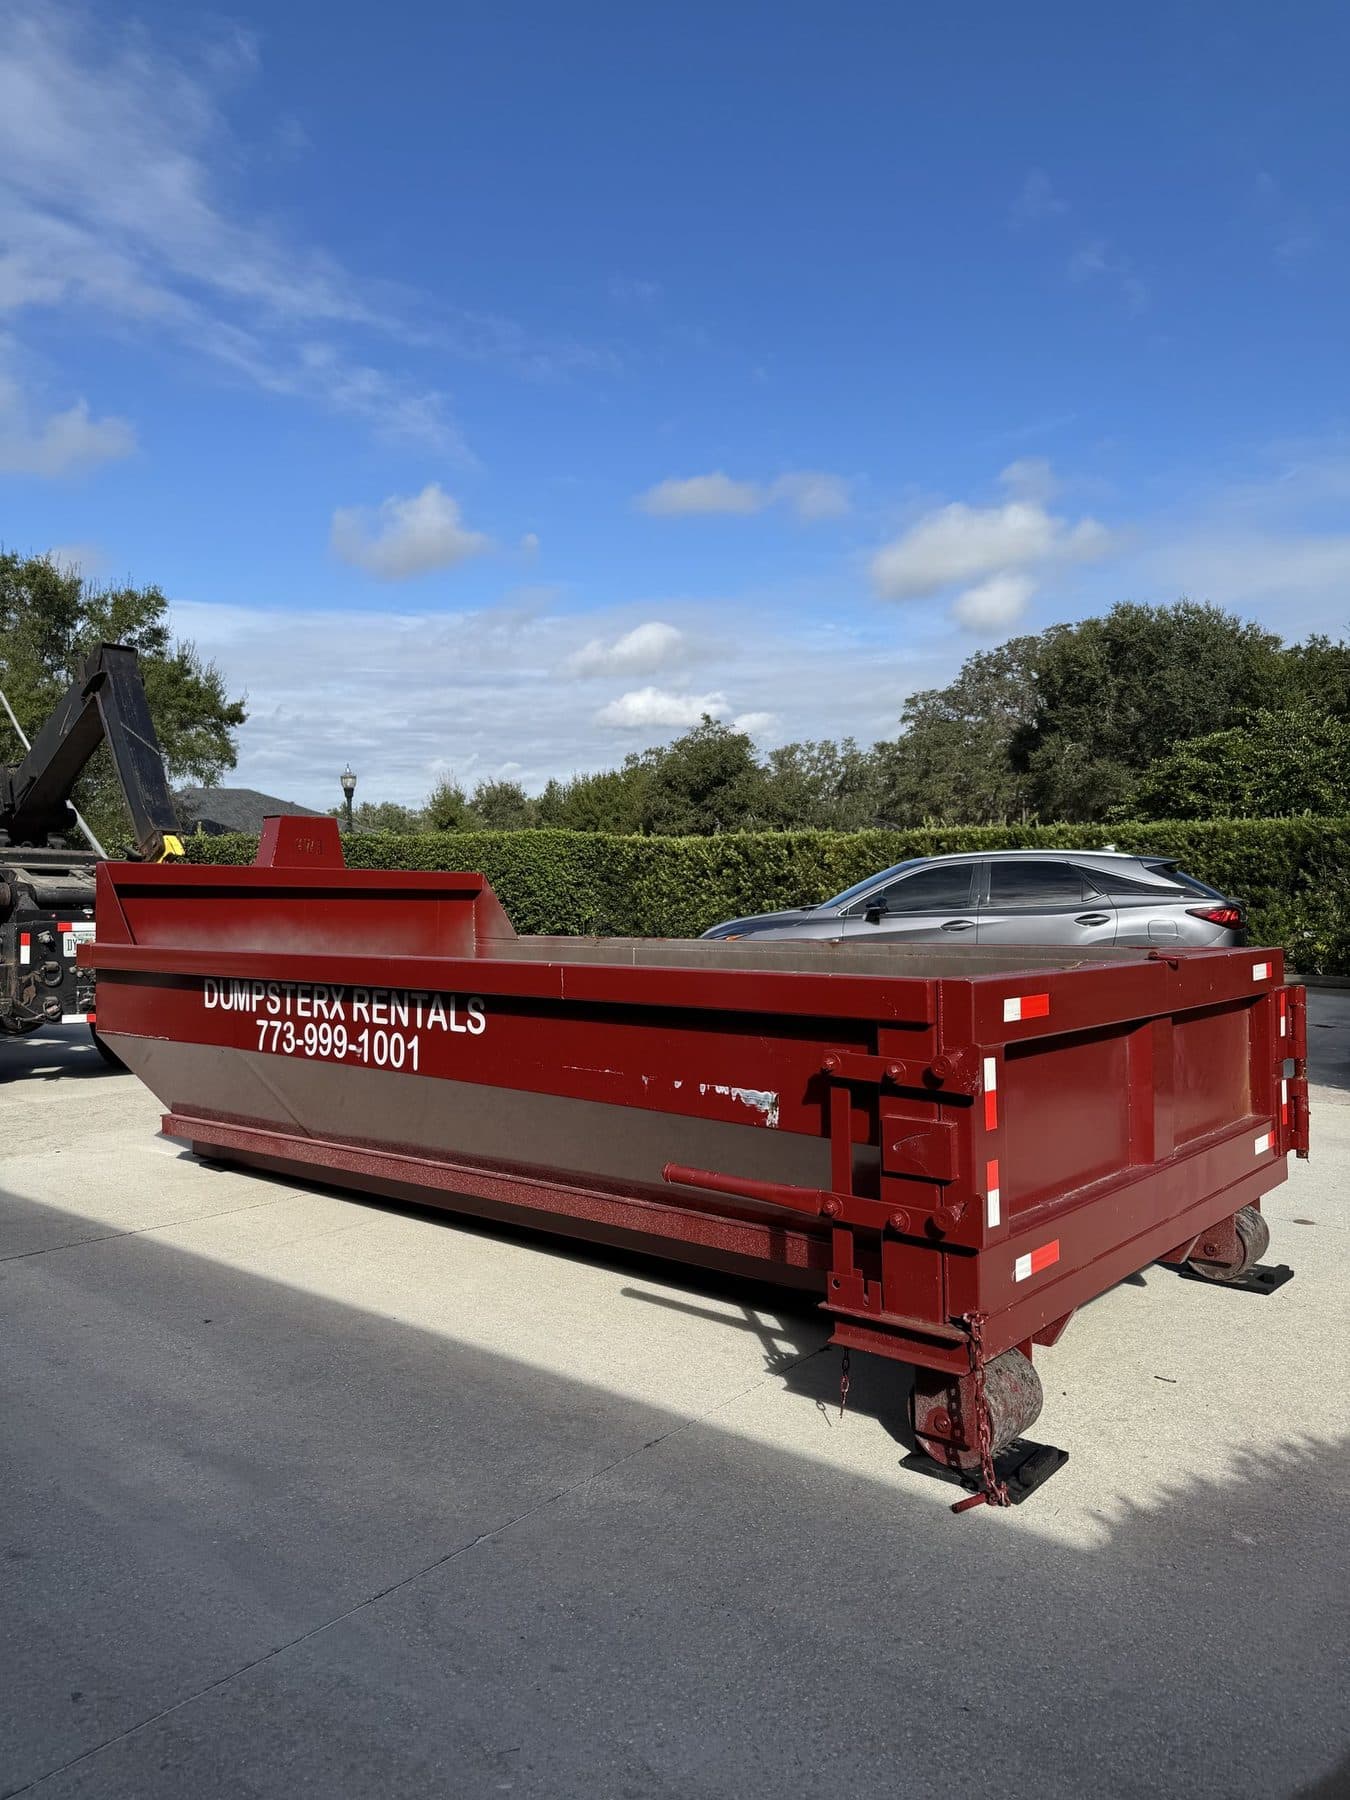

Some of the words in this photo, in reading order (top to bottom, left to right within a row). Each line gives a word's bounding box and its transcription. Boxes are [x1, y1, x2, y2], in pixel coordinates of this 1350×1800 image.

[203, 978, 345, 1021] DUMPSTERX
[352, 987, 487, 1035] RENTALS
[256, 1019, 419, 1072] 773-999-1001
